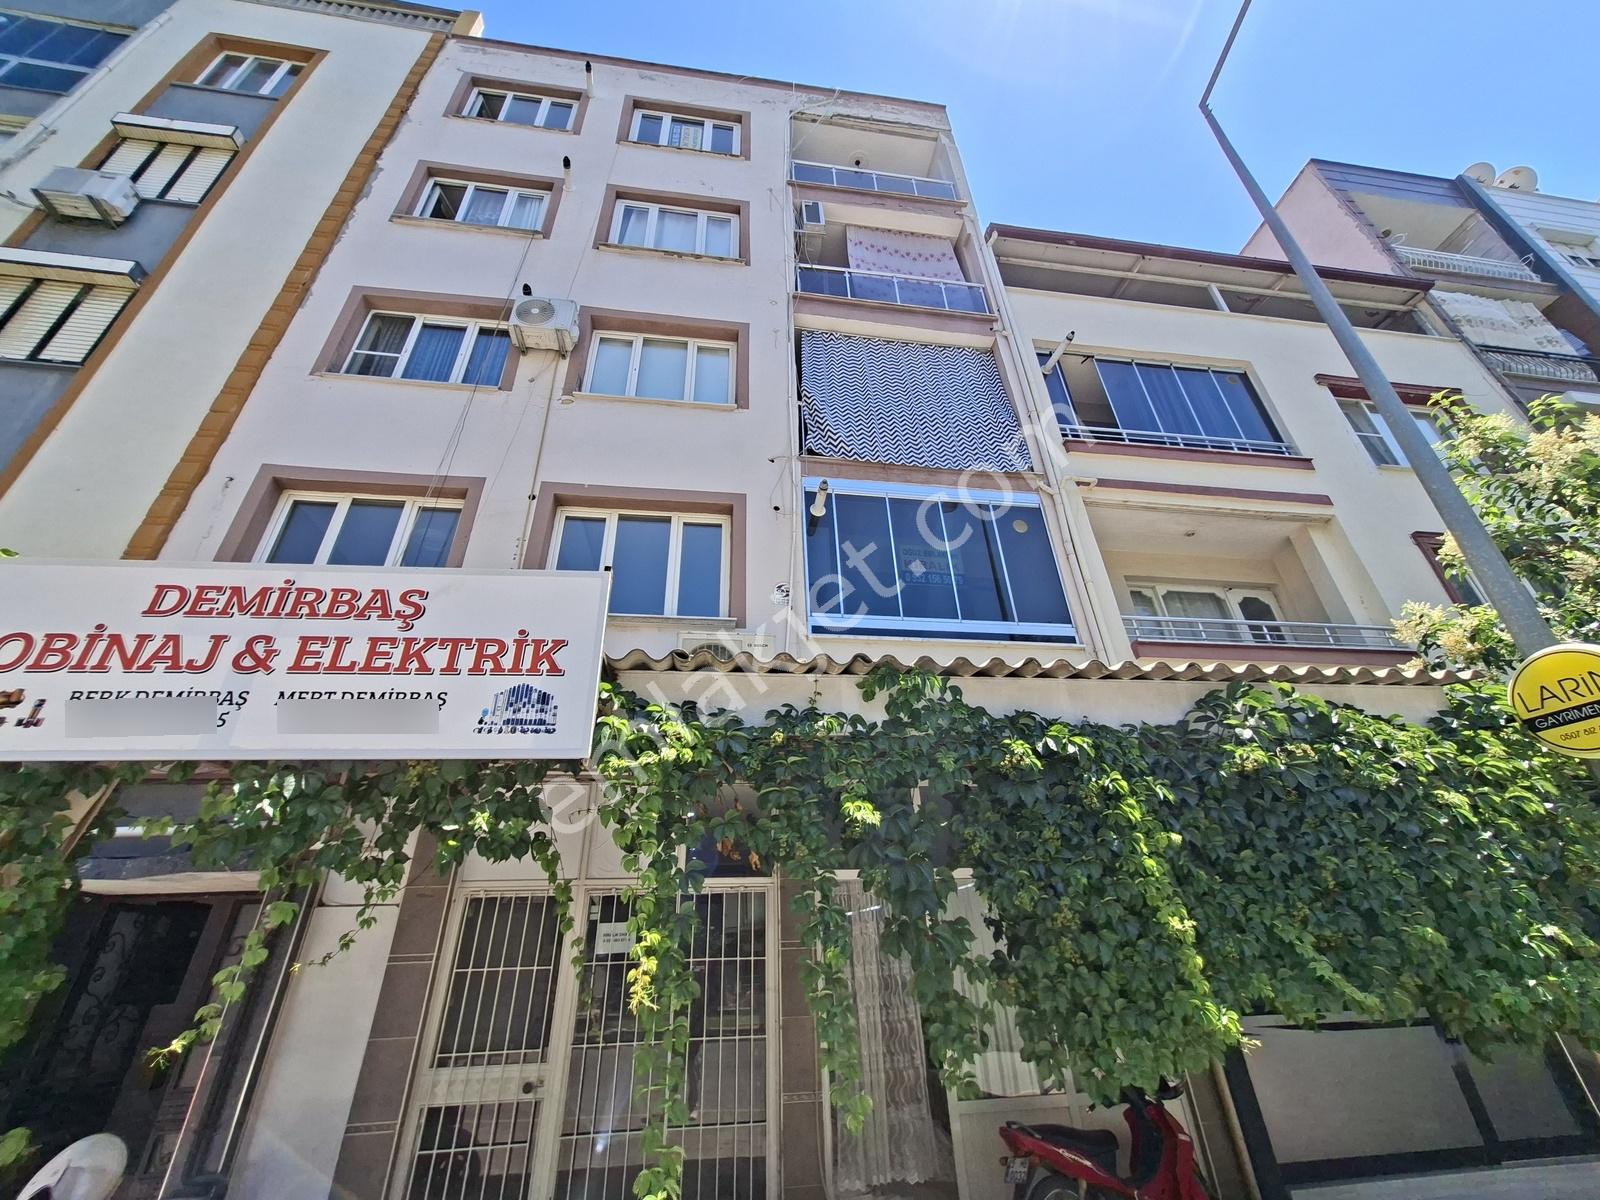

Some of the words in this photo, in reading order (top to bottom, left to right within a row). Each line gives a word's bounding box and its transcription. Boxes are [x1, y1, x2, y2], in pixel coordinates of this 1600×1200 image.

[141, 579, 429, 631] DEMİRBAŞ
[231, 635, 279, 675] &
[286, 628, 569, 676] ELEKTRİK
